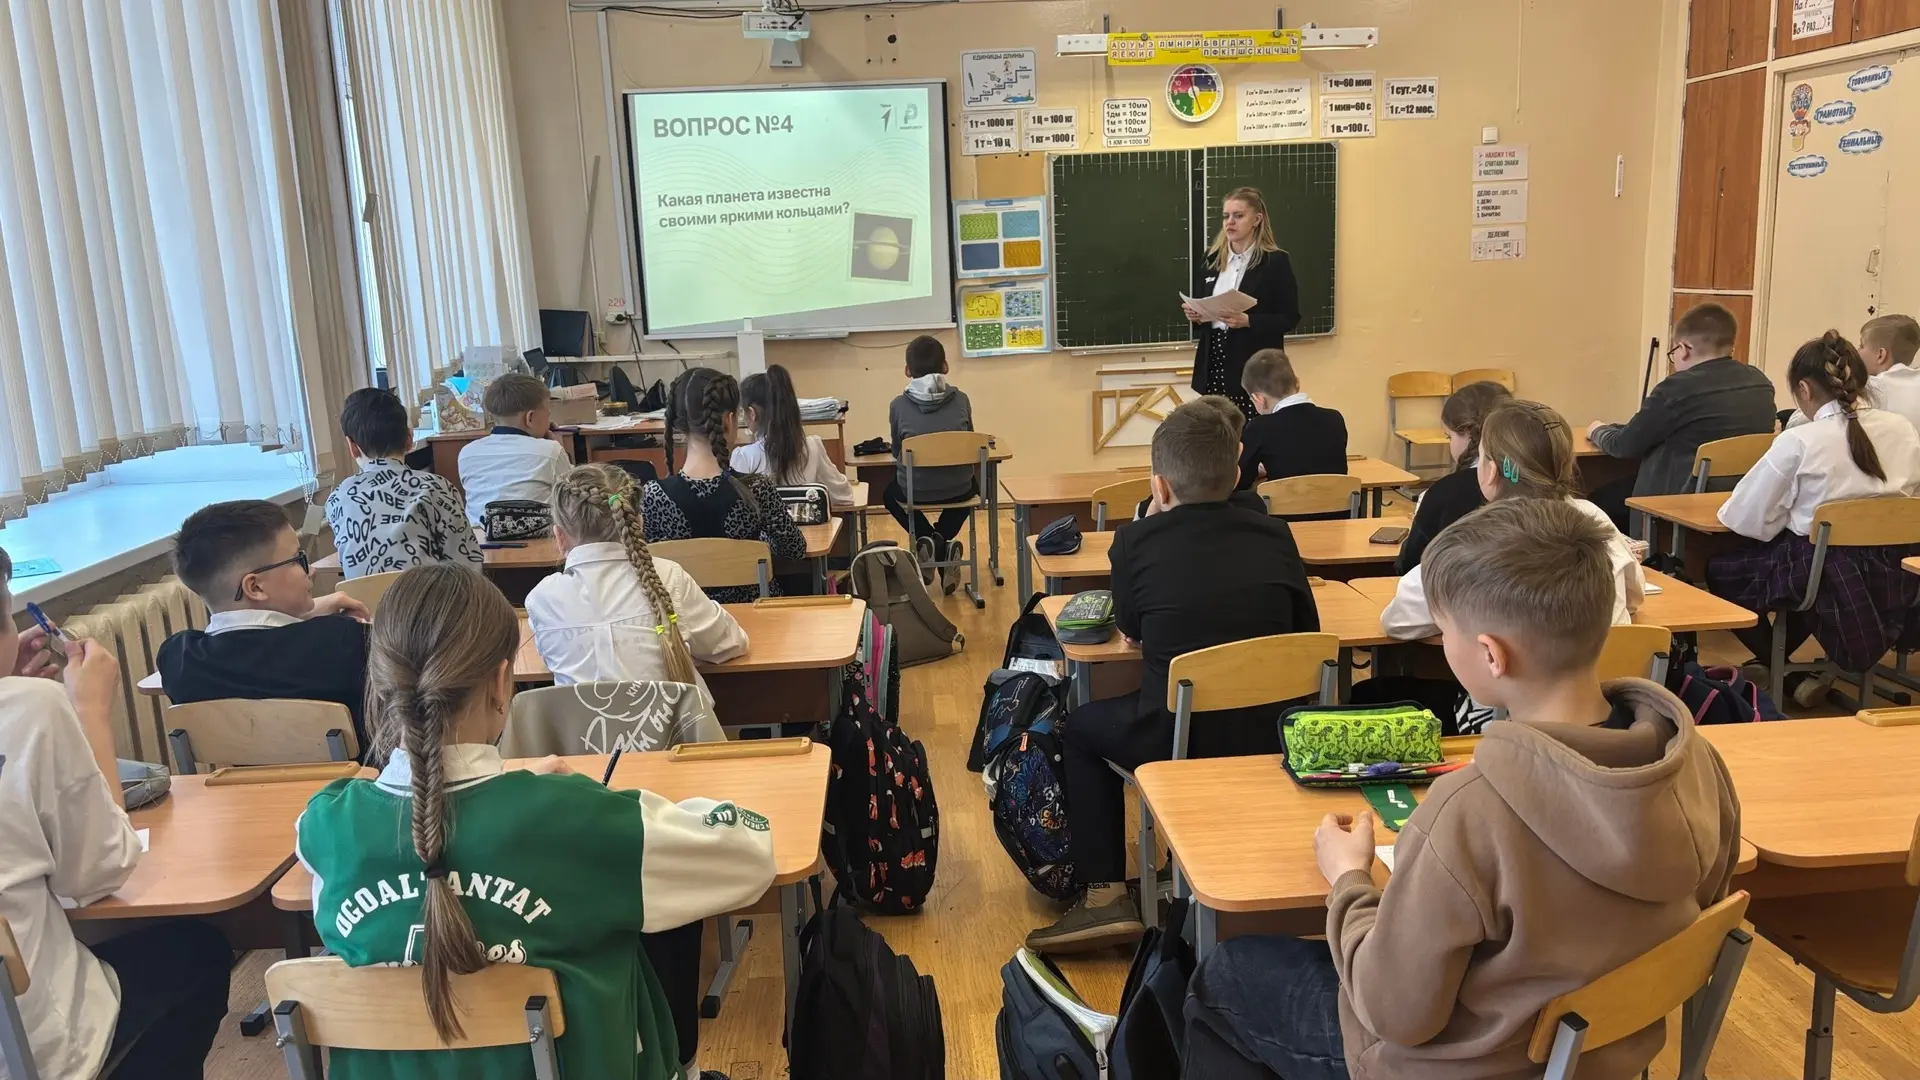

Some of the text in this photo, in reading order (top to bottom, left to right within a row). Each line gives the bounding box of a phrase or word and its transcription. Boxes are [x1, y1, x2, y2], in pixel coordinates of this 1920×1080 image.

[1355, 79, 1372, 87] мин
[1391, 86, 1394, 94] 1
[1329, 103, 1333, 111] 1
[1390, 105, 1394, 114] 1
[1816, 106, 1852, 120] ГРАМОТНЫЕ
[987, 118, 1005, 127] 1000
[1050, 115, 1063, 123] 100
[653, 115, 793, 138] ВОПРОС №4
[1331, 124, 1335, 133] 1
[994, 138, 1003, 147] 10
[1052, 134, 1070, 142] 1000
[1841, 135, 1882, 148] ГЕНИАЛЬНЫЕ
[658, 186, 831, 208] Какая планета известна
[659, 202, 850, 228] своими яркими кольцами?
[1487, 231, 1510, 239] ДЕЛЕНИЕ
[608, 297, 625, 308] 220
[368, 469, 398, 488] VIBE
[362, 490, 406, 510] VIBE
[380, 514, 418, 524] VIBE
[346, 512, 376, 544] COOL
[345, 536, 382, 568] VIBE
